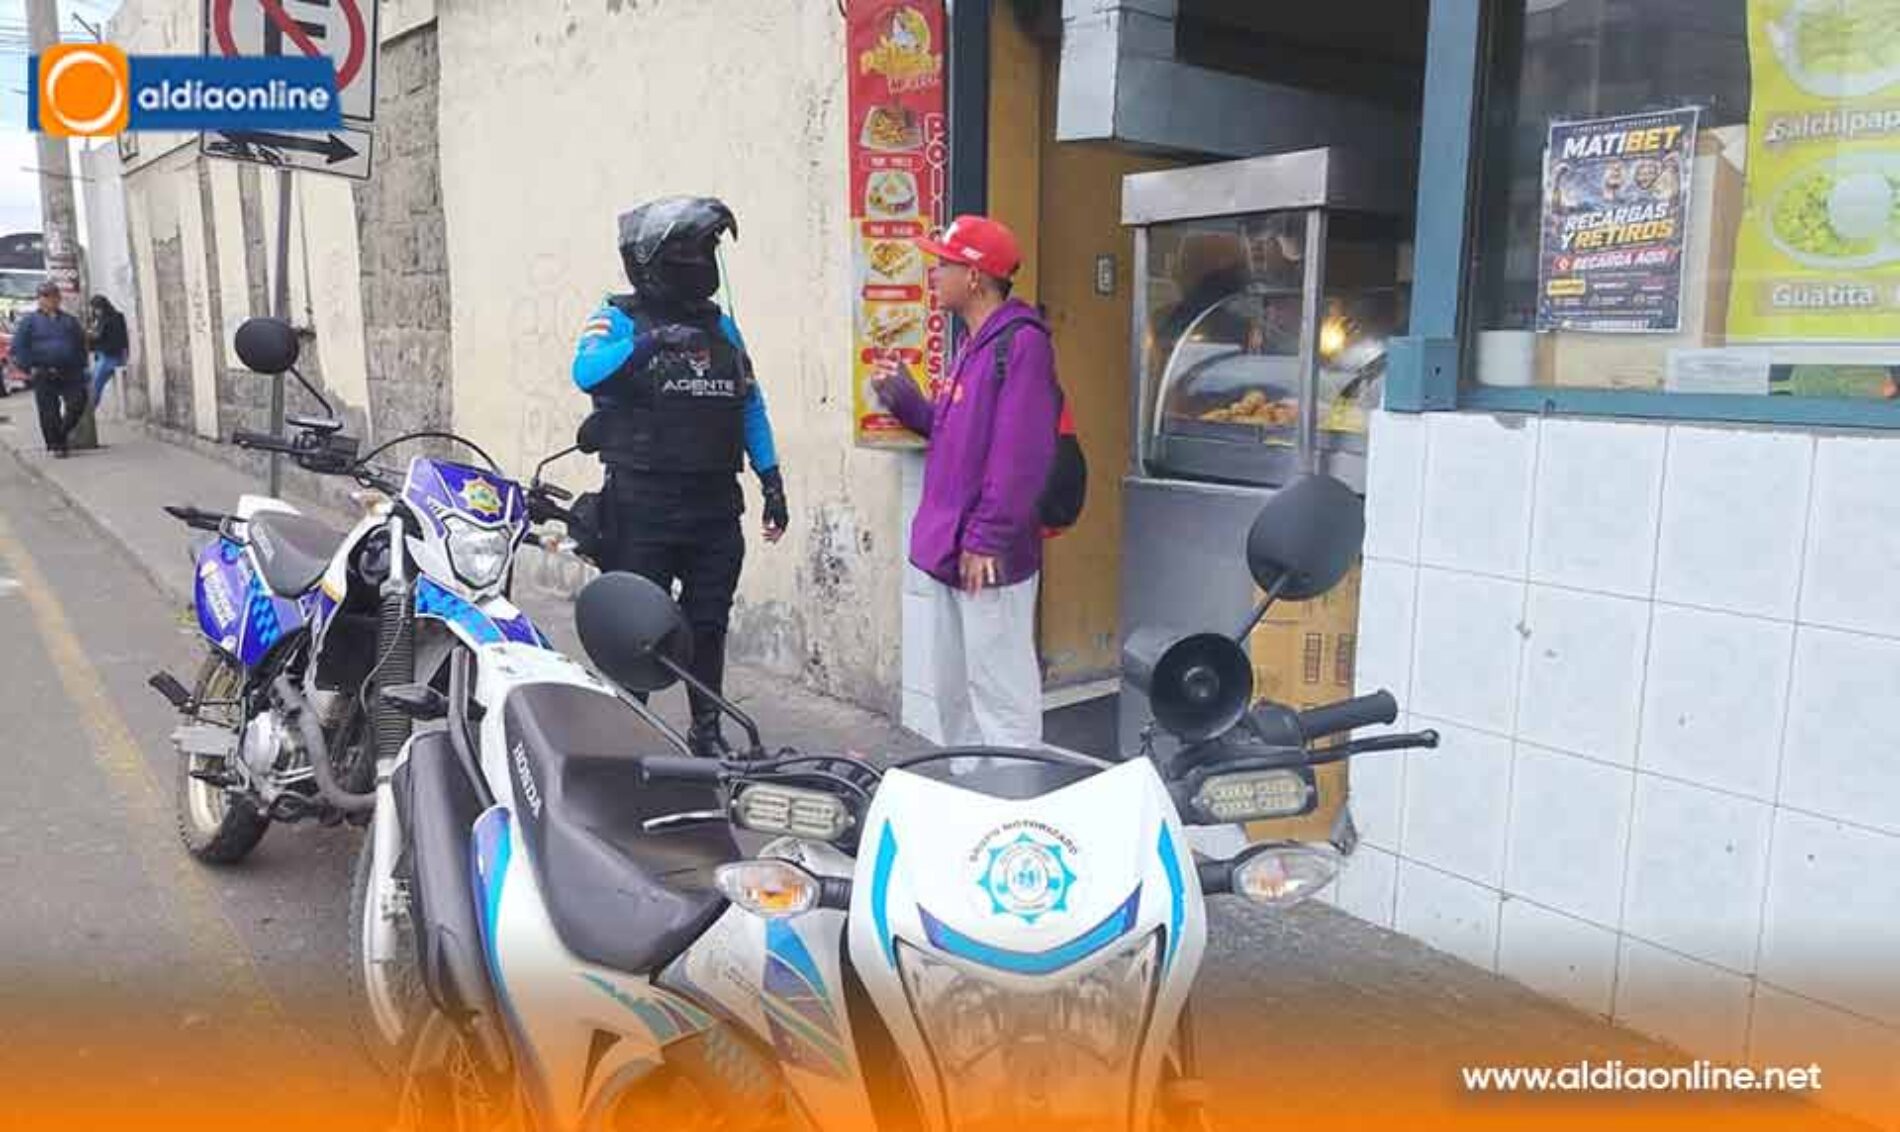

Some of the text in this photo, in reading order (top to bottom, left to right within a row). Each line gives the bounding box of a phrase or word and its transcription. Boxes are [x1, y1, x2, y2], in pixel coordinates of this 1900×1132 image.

[1562, 125, 1682, 159] MATIBET
[1564, 202, 1670, 231] RECARGAS
[1560, 218, 1676, 250] Y RETIROS
[512, 740, 542, 820] HONDA
